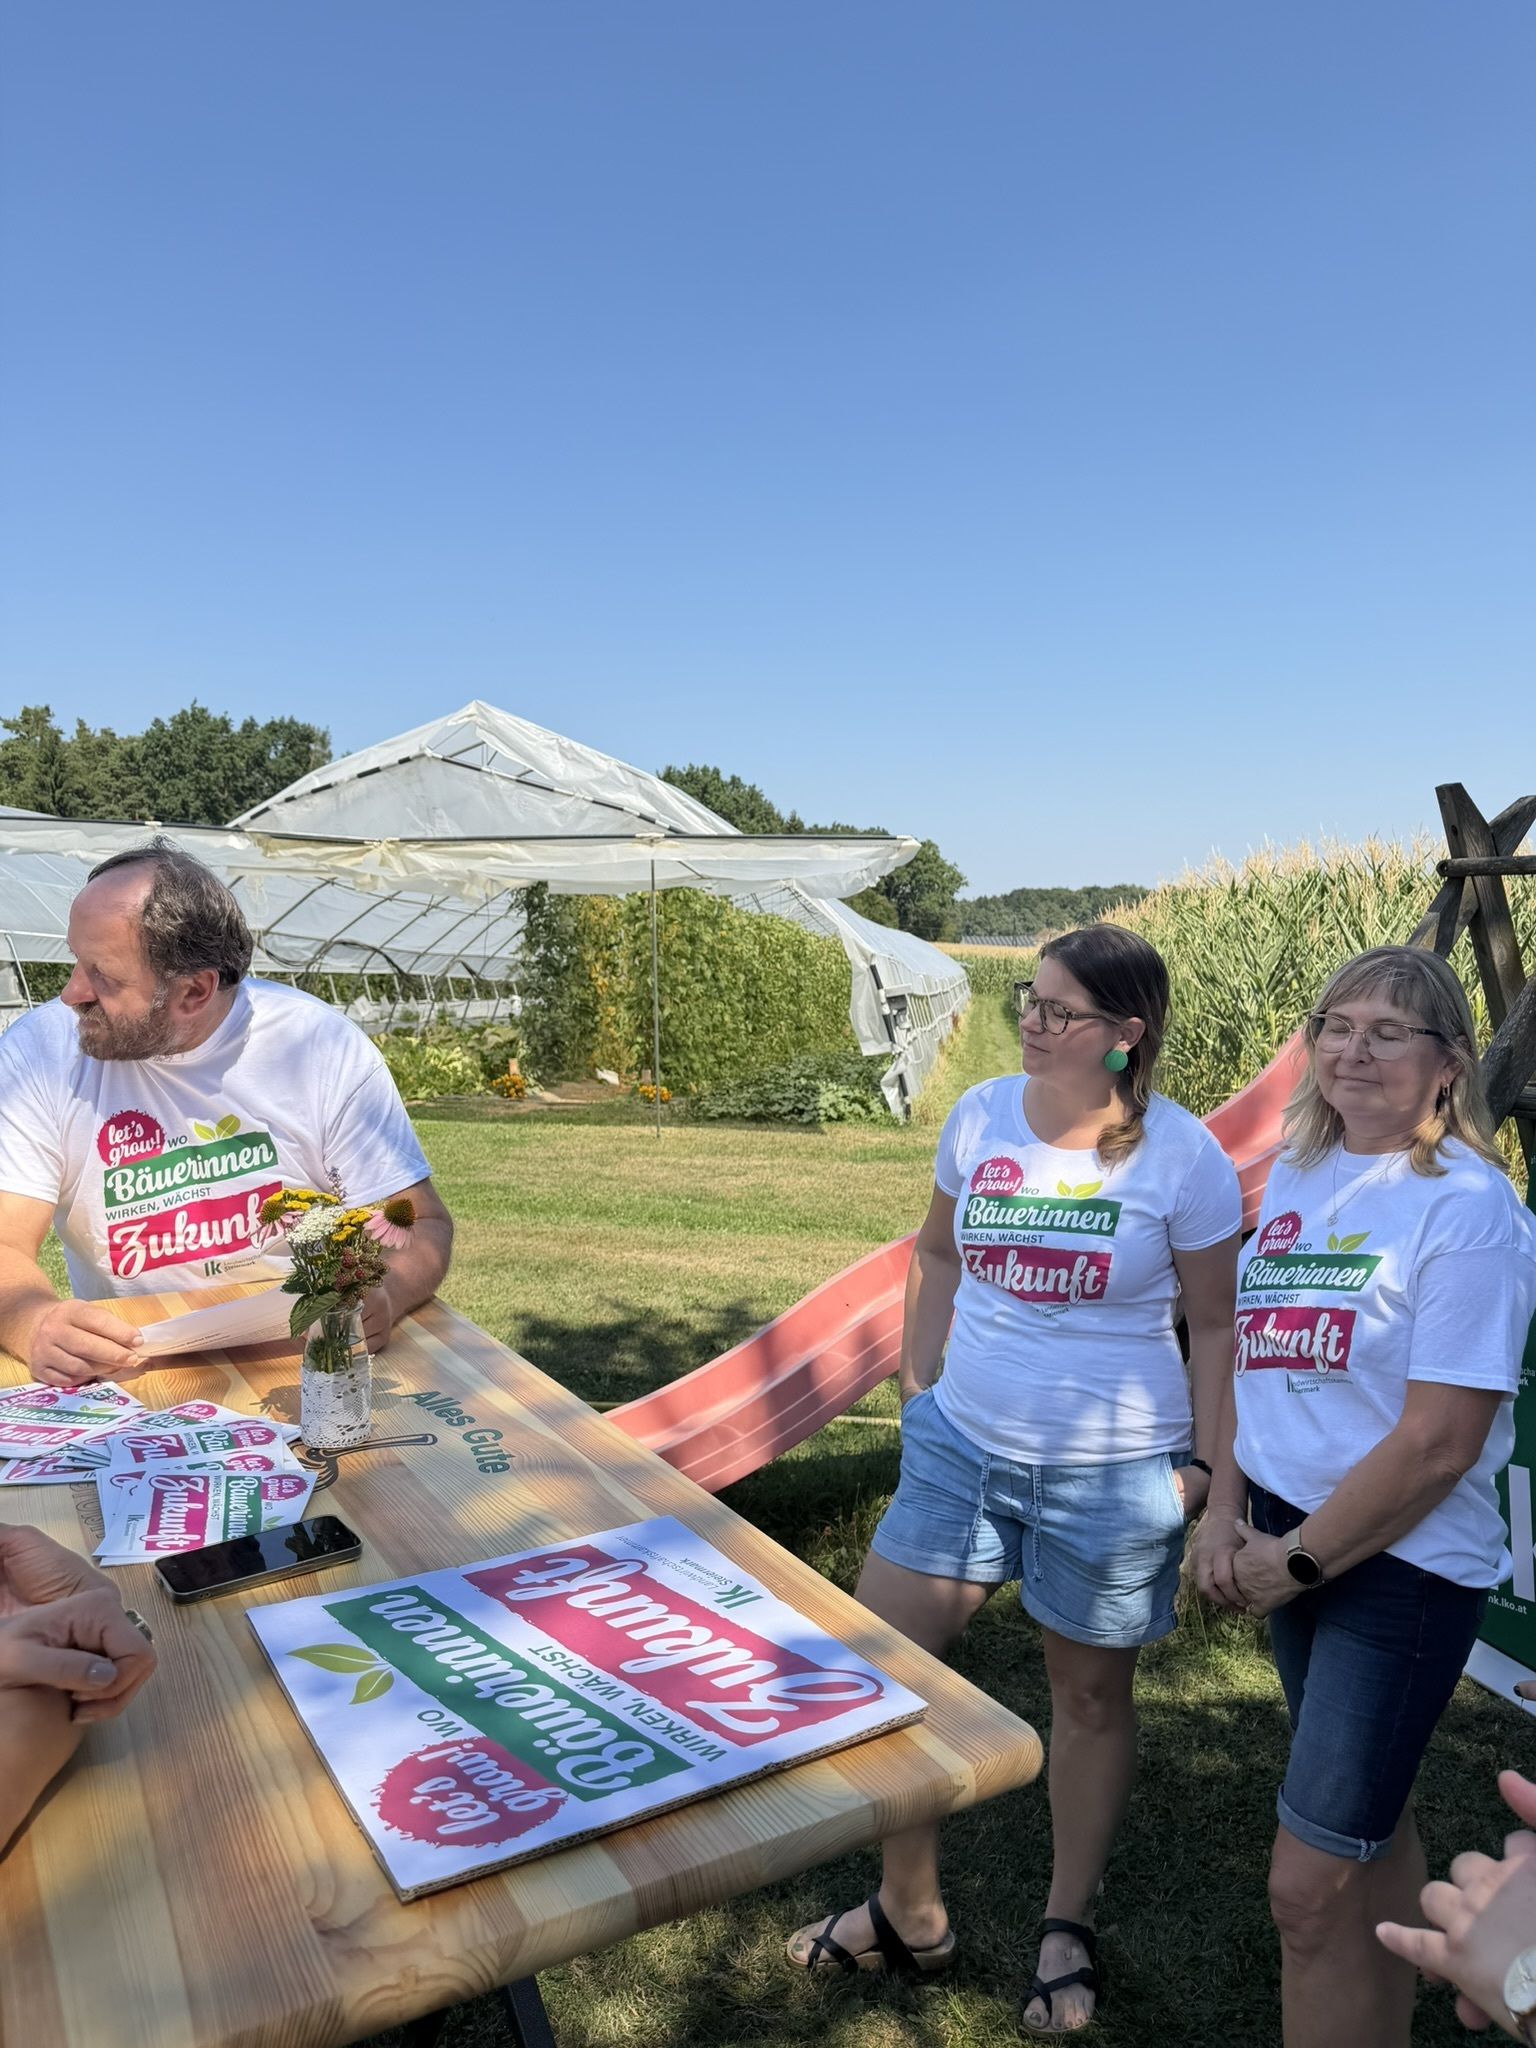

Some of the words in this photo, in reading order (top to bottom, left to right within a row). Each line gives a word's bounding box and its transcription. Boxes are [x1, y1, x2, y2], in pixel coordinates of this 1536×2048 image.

[108, 1120, 145, 1144] let's
[108, 1129, 162, 1167] grow!
[167, 1135, 188, 1149] WO
[106, 1142, 274, 1202] Bäuerinnen
[975, 1176, 1021, 1194] grow!
[982, 1162, 1011, 1179] let's
[105, 1202, 161, 1221] WIRKEN,
[163, 1187, 212, 1208] WÄCHST
[1020, 1186, 1040, 1196] WO
[967, 1197, 1114, 1232] Bäuerinnen
[1267, 1219, 1292, 1236] let's
[112, 1192, 264, 1280] Zukunf
[998, 1231, 1045, 1244] WÄCHST
[1258, 1231, 1299, 1255] grow!
[1295, 1243, 1313, 1252] WO
[965, 1249, 1102, 1304] Zukunft
[1245, 1258, 1368, 1289] Bäuerinnen
[1264, 1292, 1300, 1304] WÄCHST
[1236, 1312, 1345, 1377] Zukunft
[402, 1390, 477, 1427] Alles
[462, 1428, 517, 1474] Gute
[261, 1478, 285, 1500] grow!
[282, 1478, 300, 1493] let's
[140, 1475, 205, 1550] Zukunft
[227, 1476, 259, 1540] Bäuerinne
[615, 1535, 719, 1590] Landwirtschaftskammer
[680, 1557, 733, 1586] Steiermark
[505, 1557, 883, 1734] Zukunft
[527, 1645, 619, 1701] WÄCHST
[369, 1593, 656, 1791] Bäuerinnen
[416, 1709, 464, 1739] WO
[622, 1700, 728, 1763] WIRKEN,
[417, 1742, 569, 1812] grow!
[409, 1776, 500, 1835] let's
